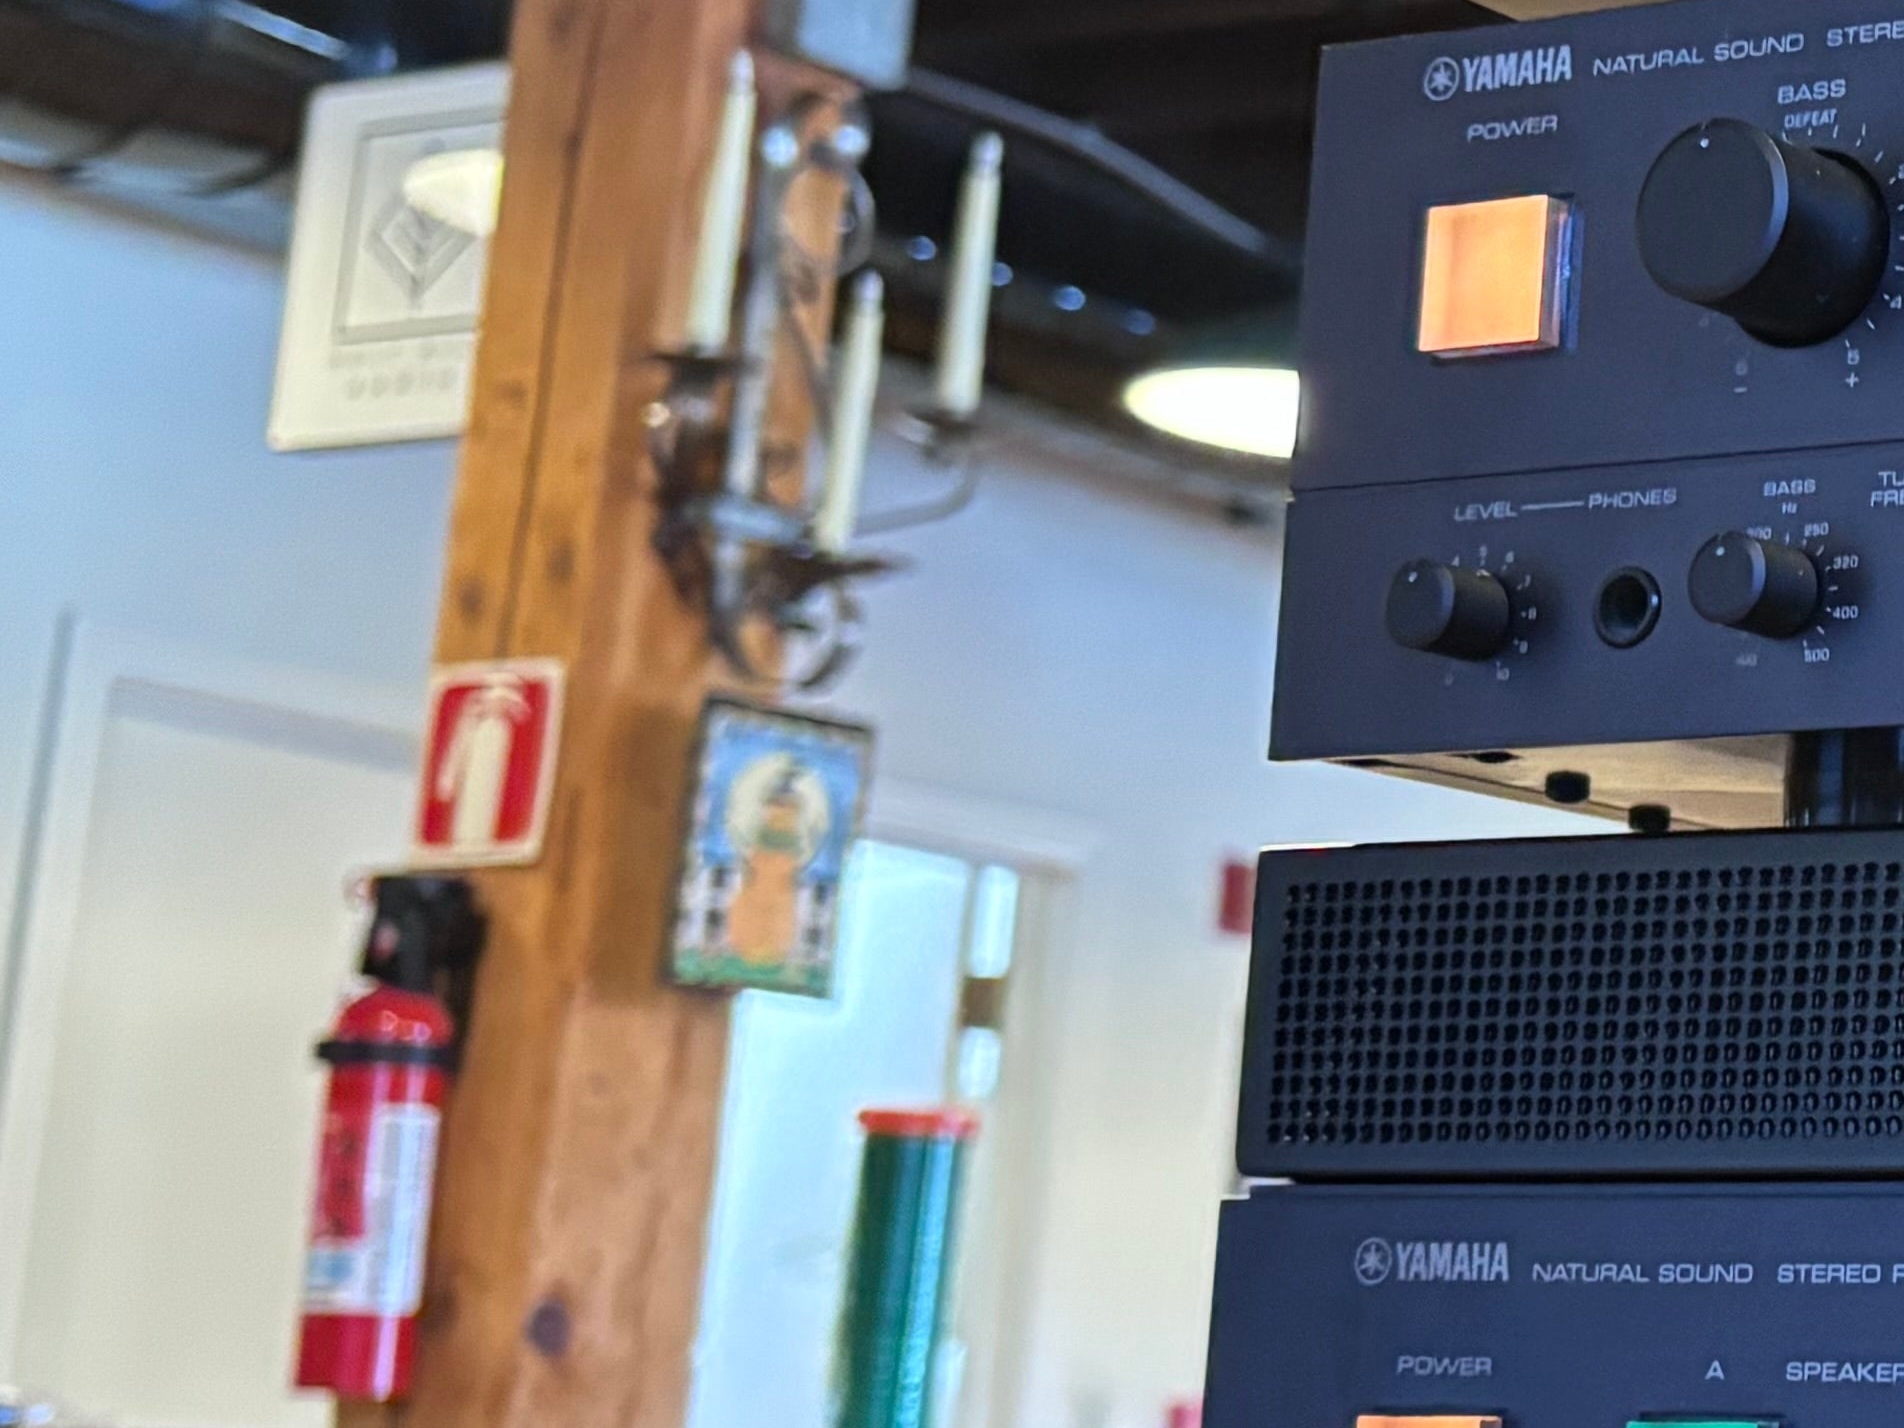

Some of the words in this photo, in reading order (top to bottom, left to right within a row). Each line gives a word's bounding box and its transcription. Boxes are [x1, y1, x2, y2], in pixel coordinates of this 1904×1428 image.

[1462, 45, 1572, 93] YAMAHA
[1593, 47, 1705, 78] NATURAL
[1713, 33, 1806, 63] SOUND
[1777, 79, 1846, 104] BASS
[1466, 115, 1559, 143] POWER
[1784, 108, 1838, 128] DEFEAT
[1763, 478, 1816, 497] BASS
[1454, 501, 1517, 522] LEVEL
[1588, 487, 1677, 510] PHONES
[1832, 605, 1859, 620] 400
[1396, 1242, 1509, 1283] YAMAHA
[1533, 1264, 1649, 1283] NATURAL
[1658, 1263, 1753, 1284] SOUND
[1777, 1263, 1881, 1284] STEREO
[1397, 1355, 1492, 1376] POWER
[1705, 1360, 1725, 1381] A
